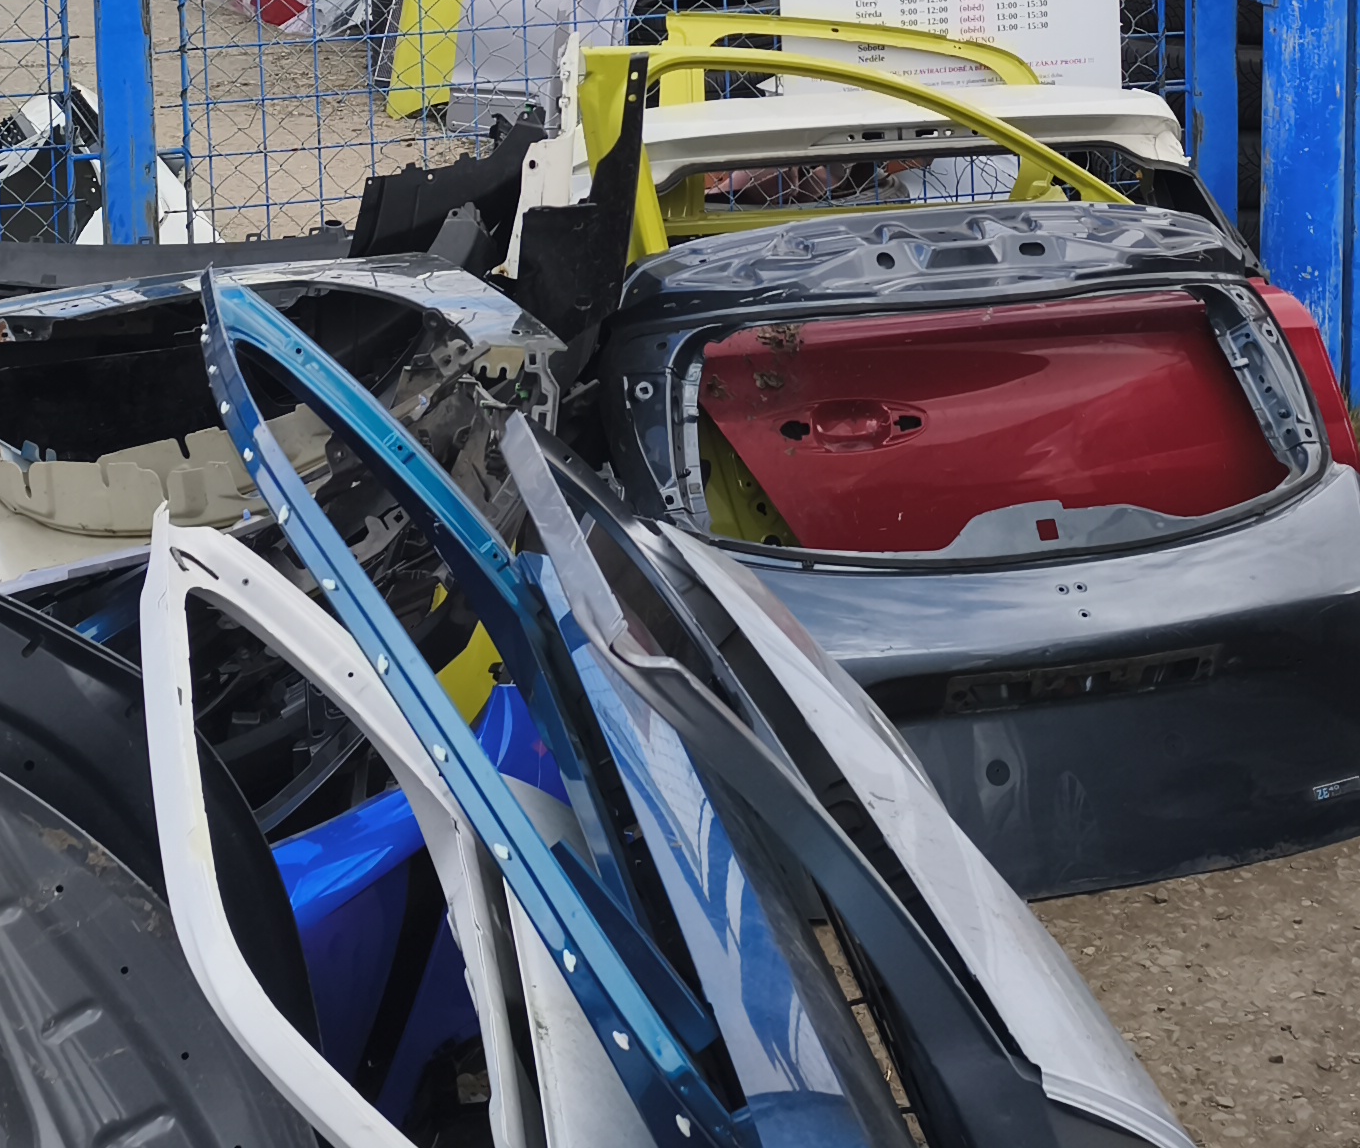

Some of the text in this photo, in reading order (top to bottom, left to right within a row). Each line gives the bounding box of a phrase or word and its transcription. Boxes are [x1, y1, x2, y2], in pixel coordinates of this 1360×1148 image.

[855, 10, 882, 19] Středa
[900, 8, 918, 16] 9:00
[927, 6, 948, 14] 12:00
[959, 4, 985, 13] (oběd)
[996, 2, 1018, 10] 13:00
[1027, 0, 1048, 8] 15:30
[900, 19, 918, 27] 9:00
[927, 17, 949, 25] 12:00
[960, 15, 985, 24] (oběd)
[997, 12, 1018, 21] 13:00
[1027, 11, 1048, 19] 15:30
[960, 26, 986, 35] (oběd)
[997, 23, 1018, 32] 13:00
[1027, 21, 1049, 30] 15:30
[857, 44, 886, 53] Sobota
[858, 54, 886, 64] Neděle
